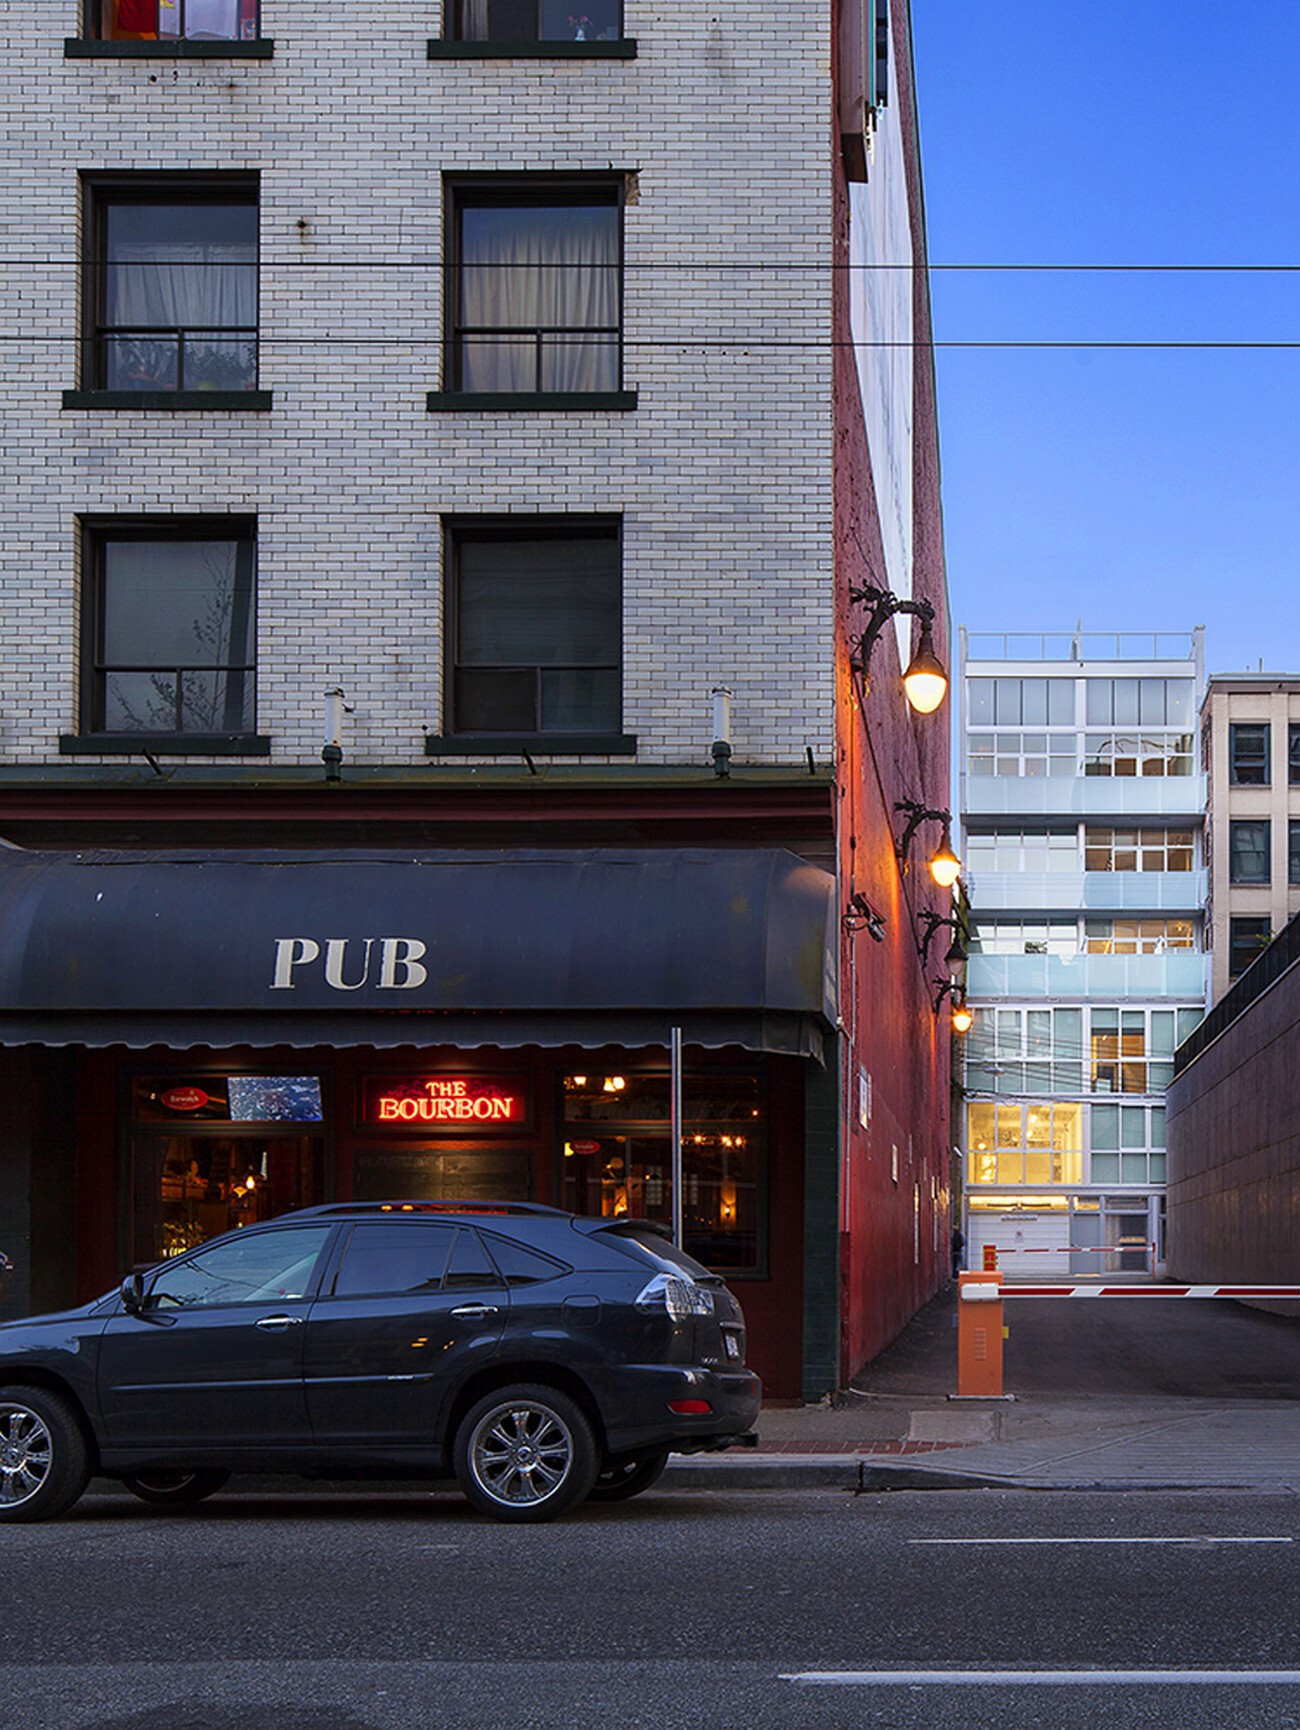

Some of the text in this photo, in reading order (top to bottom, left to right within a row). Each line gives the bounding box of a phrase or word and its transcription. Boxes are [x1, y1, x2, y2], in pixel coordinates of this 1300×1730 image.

[269, 938, 428, 990] PUB
[425, 1081, 467, 1097] THE
[379, 1097, 513, 1119] BOURBON
